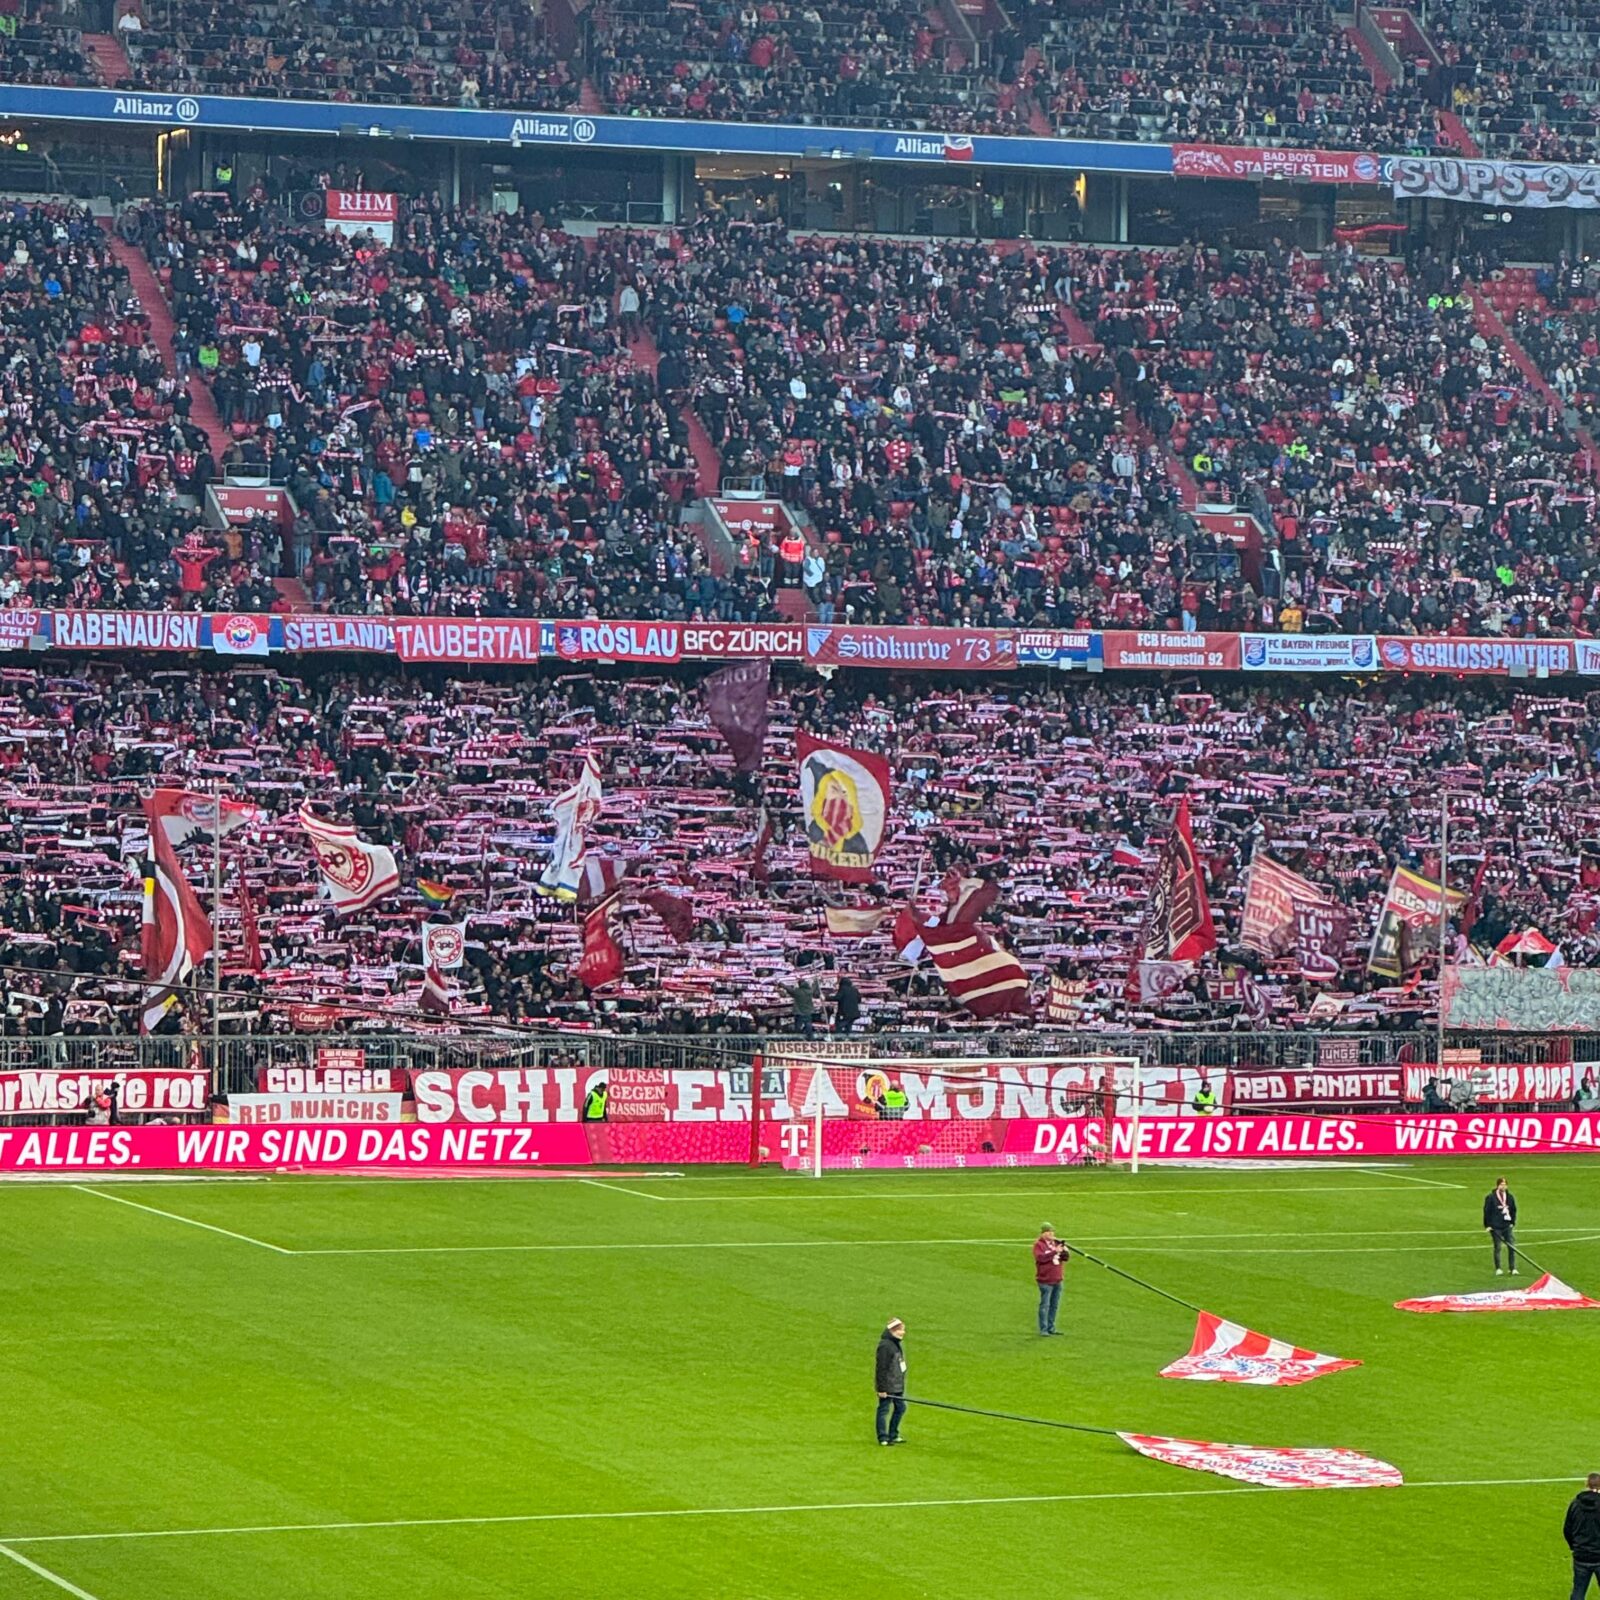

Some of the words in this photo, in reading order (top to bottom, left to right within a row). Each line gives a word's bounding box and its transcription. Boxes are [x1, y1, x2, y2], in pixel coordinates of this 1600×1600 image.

[113, 97, 173, 116] Allianz
[512, 118, 568, 137] Allianz
[1263, 151, 1286, 162] BAD
[1288, 152, 1316, 164] BOYS
[1400, 160, 1528, 201] SUPS
[339, 193, 393, 211] RHM
[55, 613, 198, 648] RABENAU/SN
[285, 622, 388, 650] SEELAND
[397, 624, 537, 659] TAUBERTAL
[581, 624, 678, 657] RÖSLAU
[684, 630, 724, 650] BFC
[727, 628, 802, 652] ZÜRICH
[1020, 634, 1051, 646] LETZTE
[1062, 635, 1089, 647] REIHE
[1137, 633, 1159, 647] FCB
[1161, 633, 1206, 648] Fanclub
[838, 633, 951, 661] Südkurve
[1269, 639, 1279, 648] FC
[1281, 639, 1313, 649] BAYERN
[1120, 651, 1153, 665] Sankt
[1154, 652, 1205, 666] Augustin
[1411, 643, 1569, 670] SCHLOSSPANTHER
[768, 1042, 869, 1054] AUSGESPERRTE
[610, 1068, 665, 1083] ULTRAS
[1524, 1066, 1574, 1100] PRIDE
[153, 1074, 206, 1109] rot
[610, 1084, 666, 1100] GEGEN
[239, 1103, 281, 1124] RED
[607, 1101, 666, 1116] RASSISMUS
[177, 1130, 250, 1163] WIR
[259, 1129, 348, 1163] SIND
[357, 1128, 430, 1162] DAS
[440, 1128, 540, 1161] NETZ.
[1033, 1122, 1101, 1154] DAS
[1112, 1122, 1195, 1153] NETZ
[1202, 1121, 1254, 1153] IST
[1257, 1120, 1364, 1151] ALLES.
[1394, 1118, 1459, 1149] WIR
[1465, 1118, 1543, 1150] SIND
[16, 1131, 141, 1165] ALLES.
